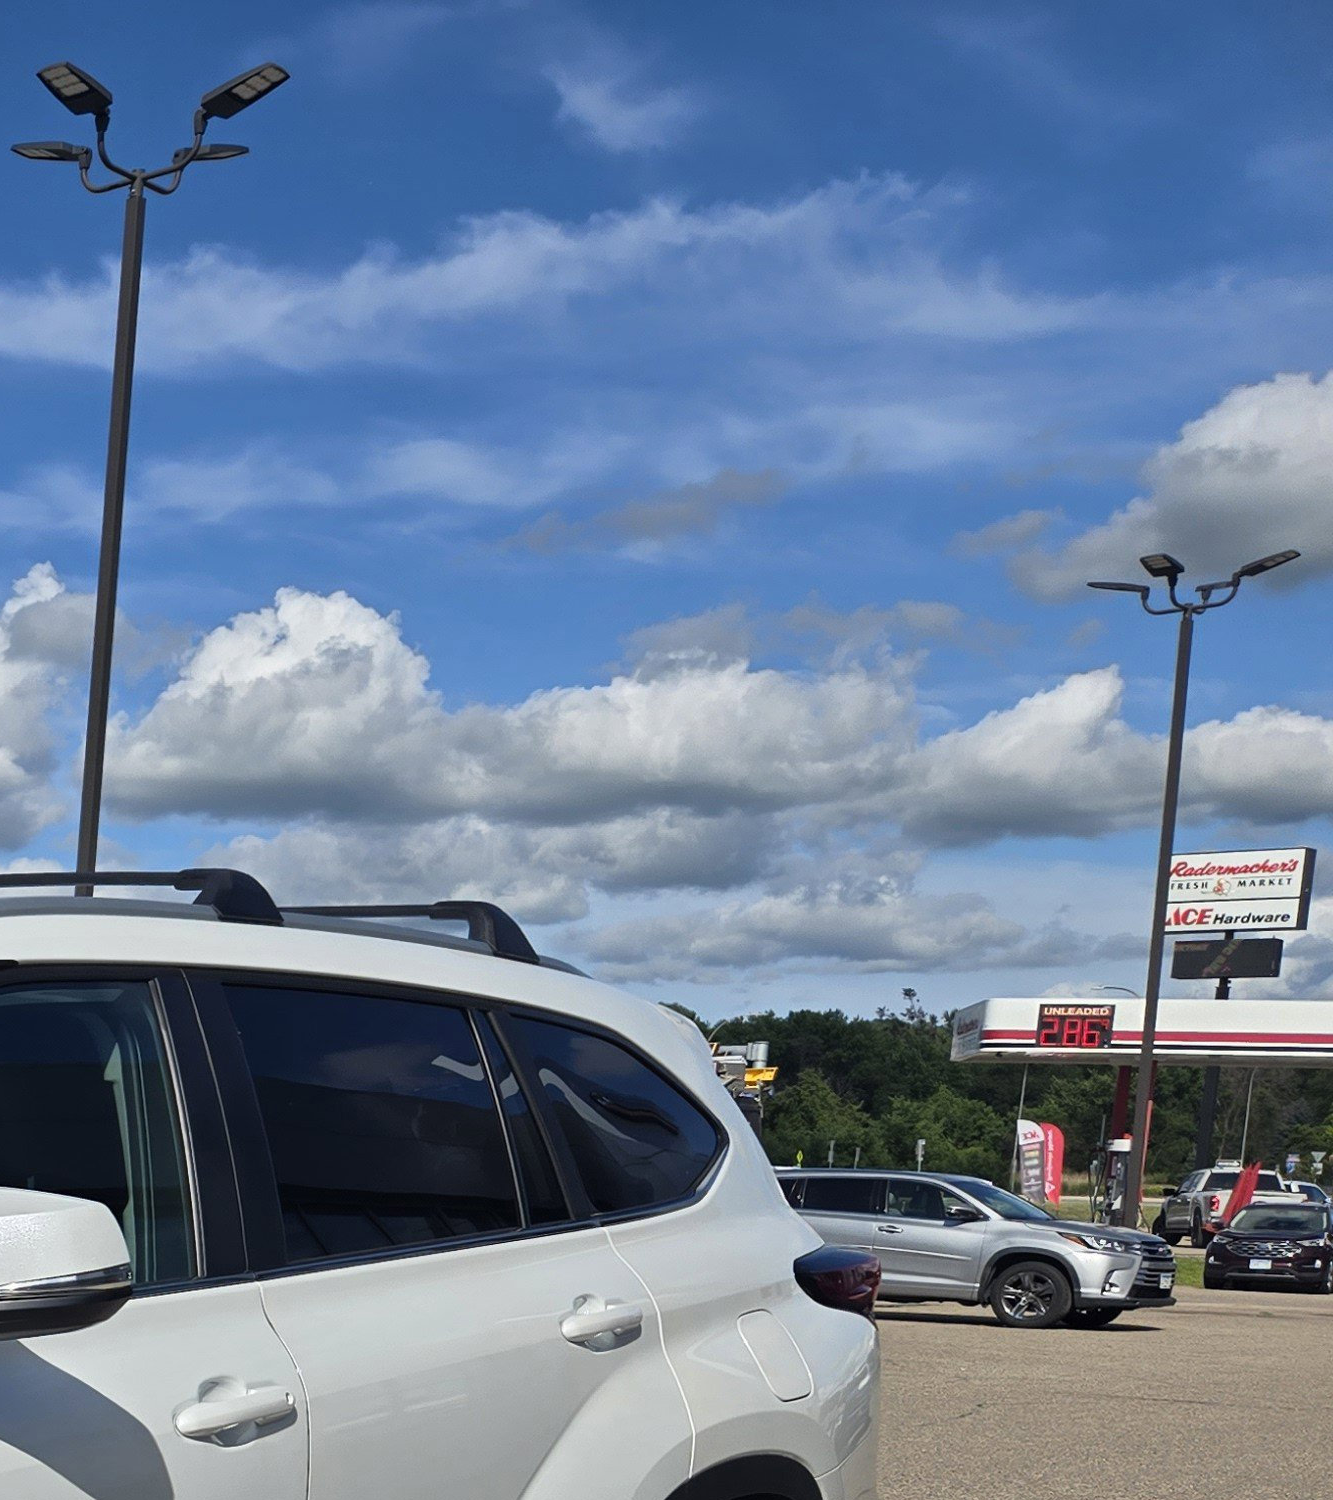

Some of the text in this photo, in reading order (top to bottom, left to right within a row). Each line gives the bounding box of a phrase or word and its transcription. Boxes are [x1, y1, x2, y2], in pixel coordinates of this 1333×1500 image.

[1170, 859, 1299, 877] Radermacher's
[1171, 878, 1292, 890] FRESH MARKET
[1165, 907, 1291, 926] ACE Hardware
[1044, 1007, 1110, 1016] UNLEADED
